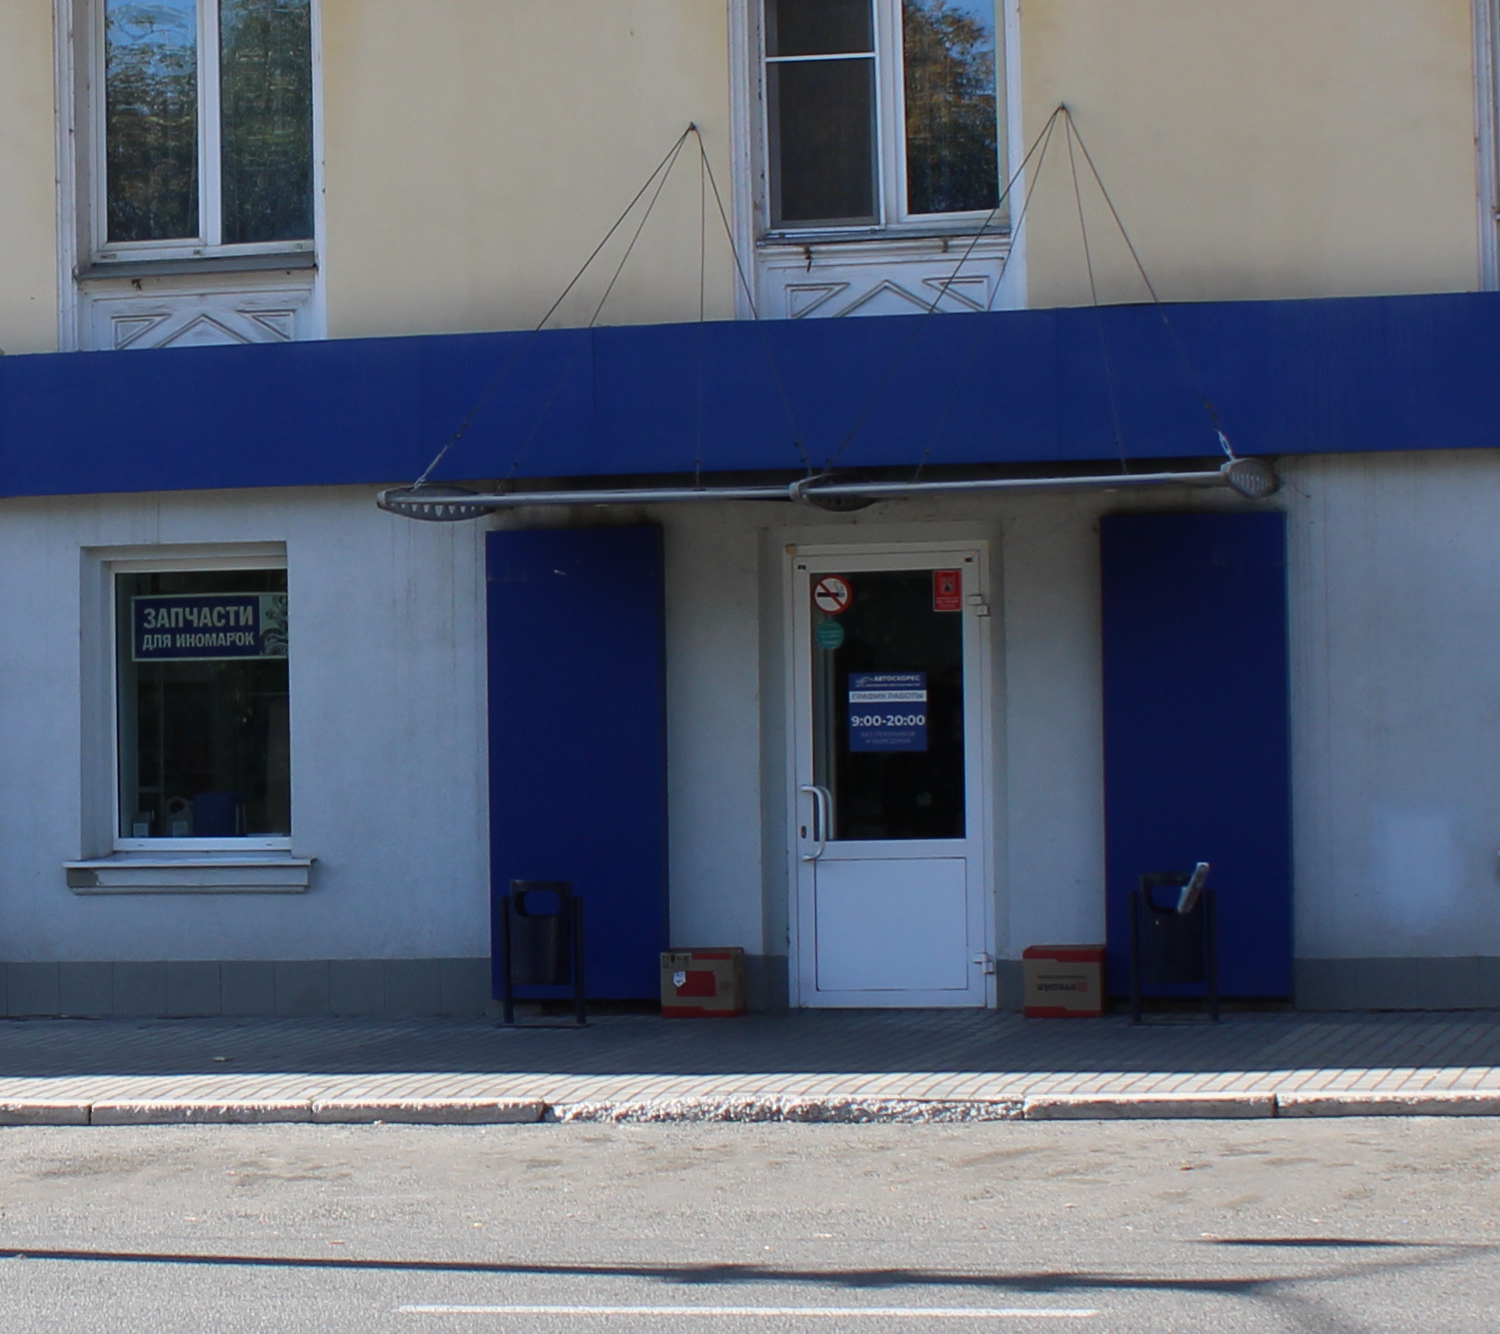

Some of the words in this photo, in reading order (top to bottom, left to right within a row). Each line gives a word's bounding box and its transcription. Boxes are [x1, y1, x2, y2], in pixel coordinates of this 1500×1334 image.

[143, 605, 254, 629] ЗАПЧАСТИ
[142, 634, 171, 651] ДЛЯ
[176, 631, 254, 648] ИНОМАРОК
[850, 714, 926, 727] 9:00-20:00
